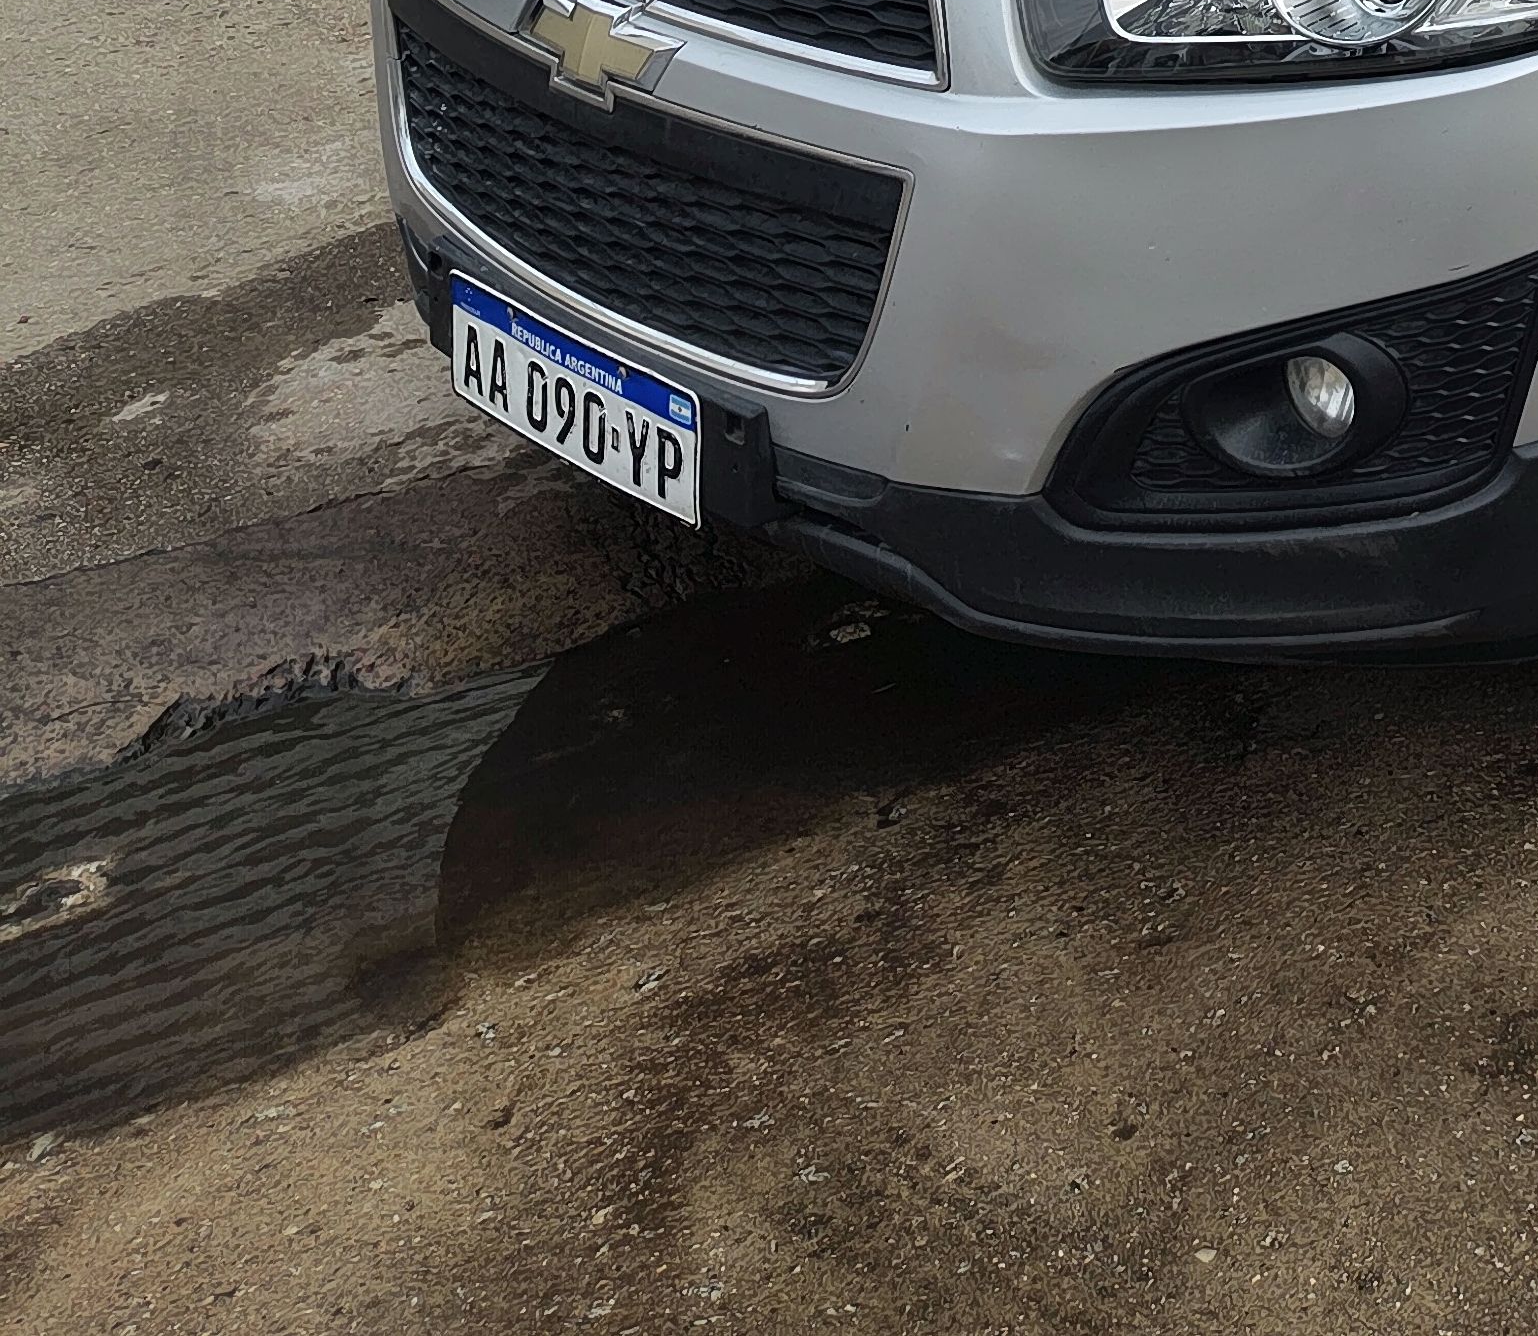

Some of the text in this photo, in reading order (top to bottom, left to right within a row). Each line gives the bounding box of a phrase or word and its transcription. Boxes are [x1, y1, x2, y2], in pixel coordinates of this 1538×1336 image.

[464, 324, 683, 499] AA 090 YP
[564, 353, 623, 395] ARGENTINA
